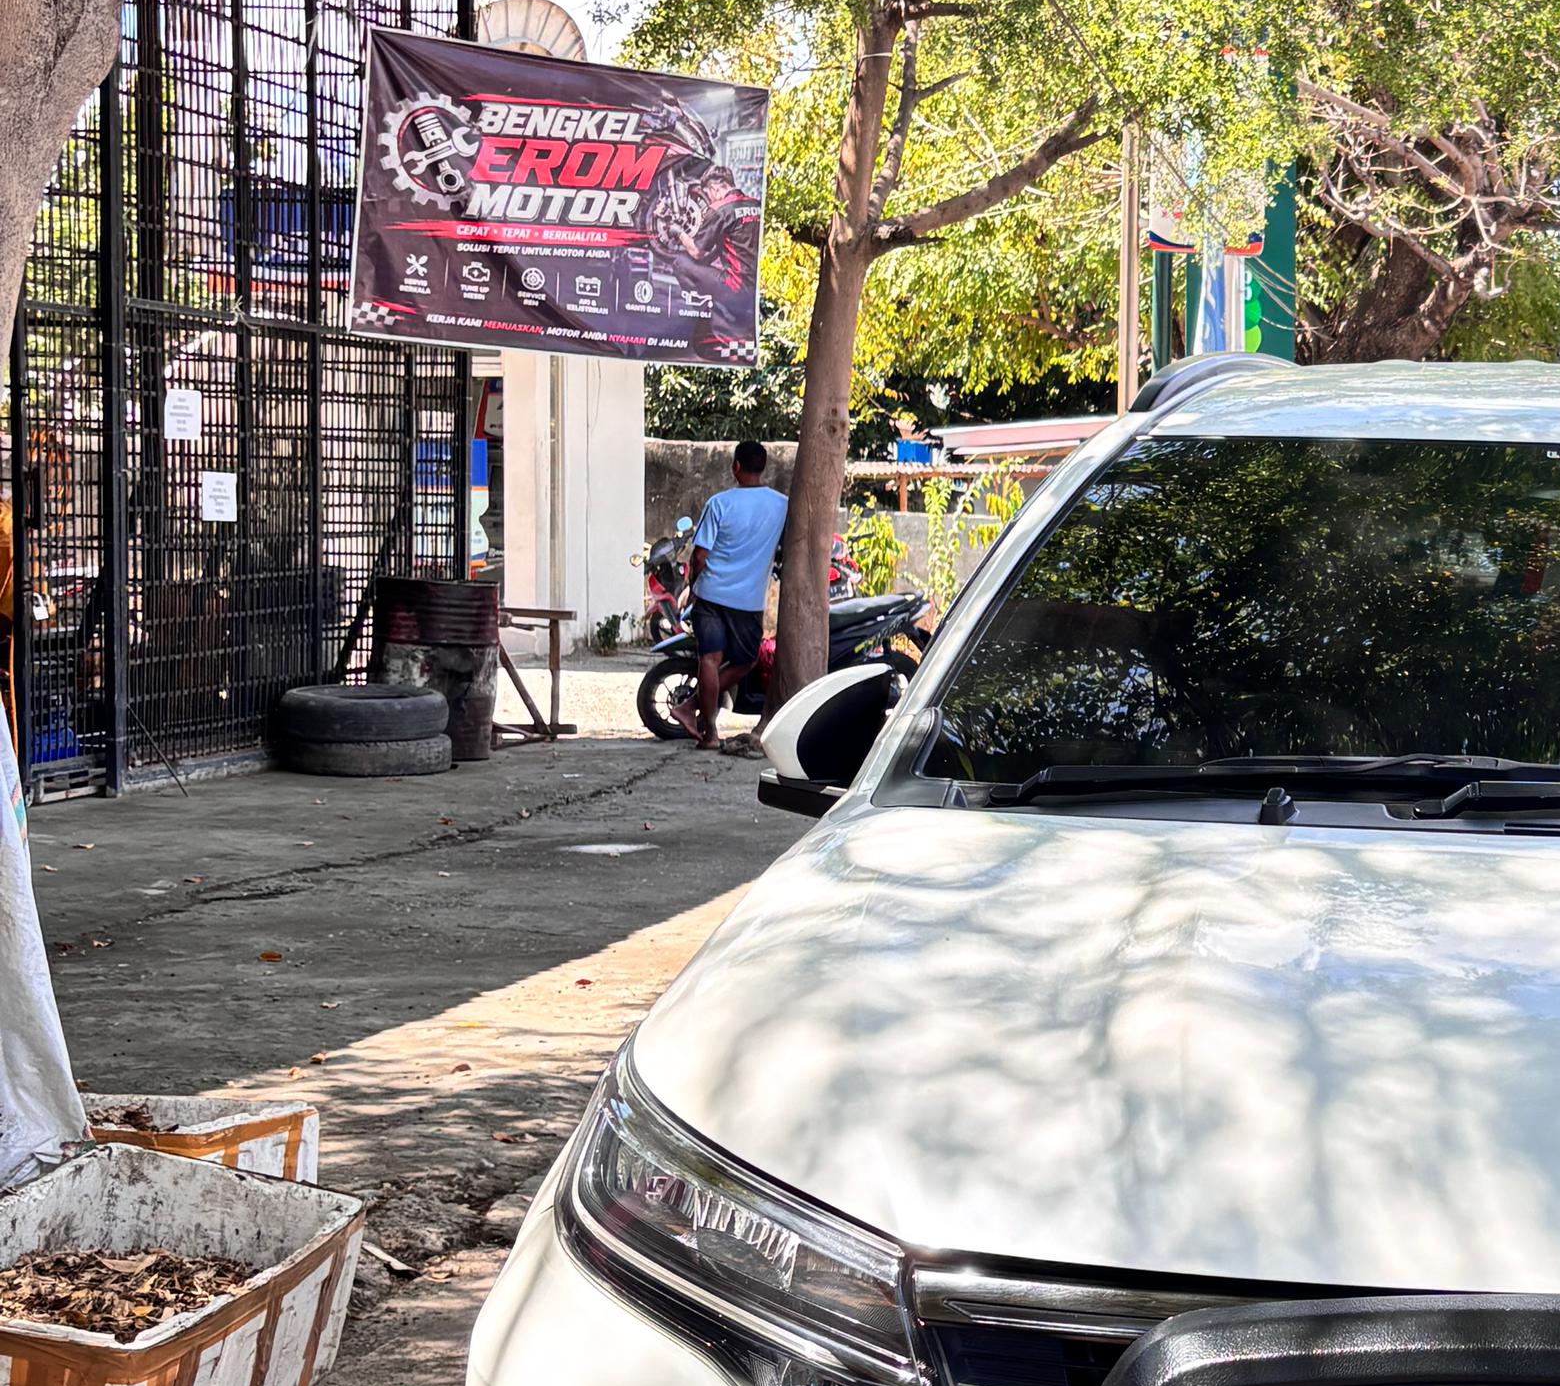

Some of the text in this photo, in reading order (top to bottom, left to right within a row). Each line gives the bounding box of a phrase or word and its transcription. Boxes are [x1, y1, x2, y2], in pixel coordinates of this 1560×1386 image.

[479, 102, 647, 142] BENGKEL
[470, 136, 667, 190] EROM
[462, 183, 640, 226] MOTOR
[456, 224, 608, 242] CEPAT TEPAT BERKUALITAS
[457, 243, 610, 259] SOLUSI TEPAT UNTUK MOTOR ANDA
[426, 314, 457, 325] KERJA
[457, 317, 482, 328] KAMI
[546, 326, 580, 338] MOTOR
[581, 330, 607, 342] ANDA
[608, 334, 646, 345] NYAMAN
[647, 337, 658, 346] DI
[658, 339, 688, 349] JALAN
